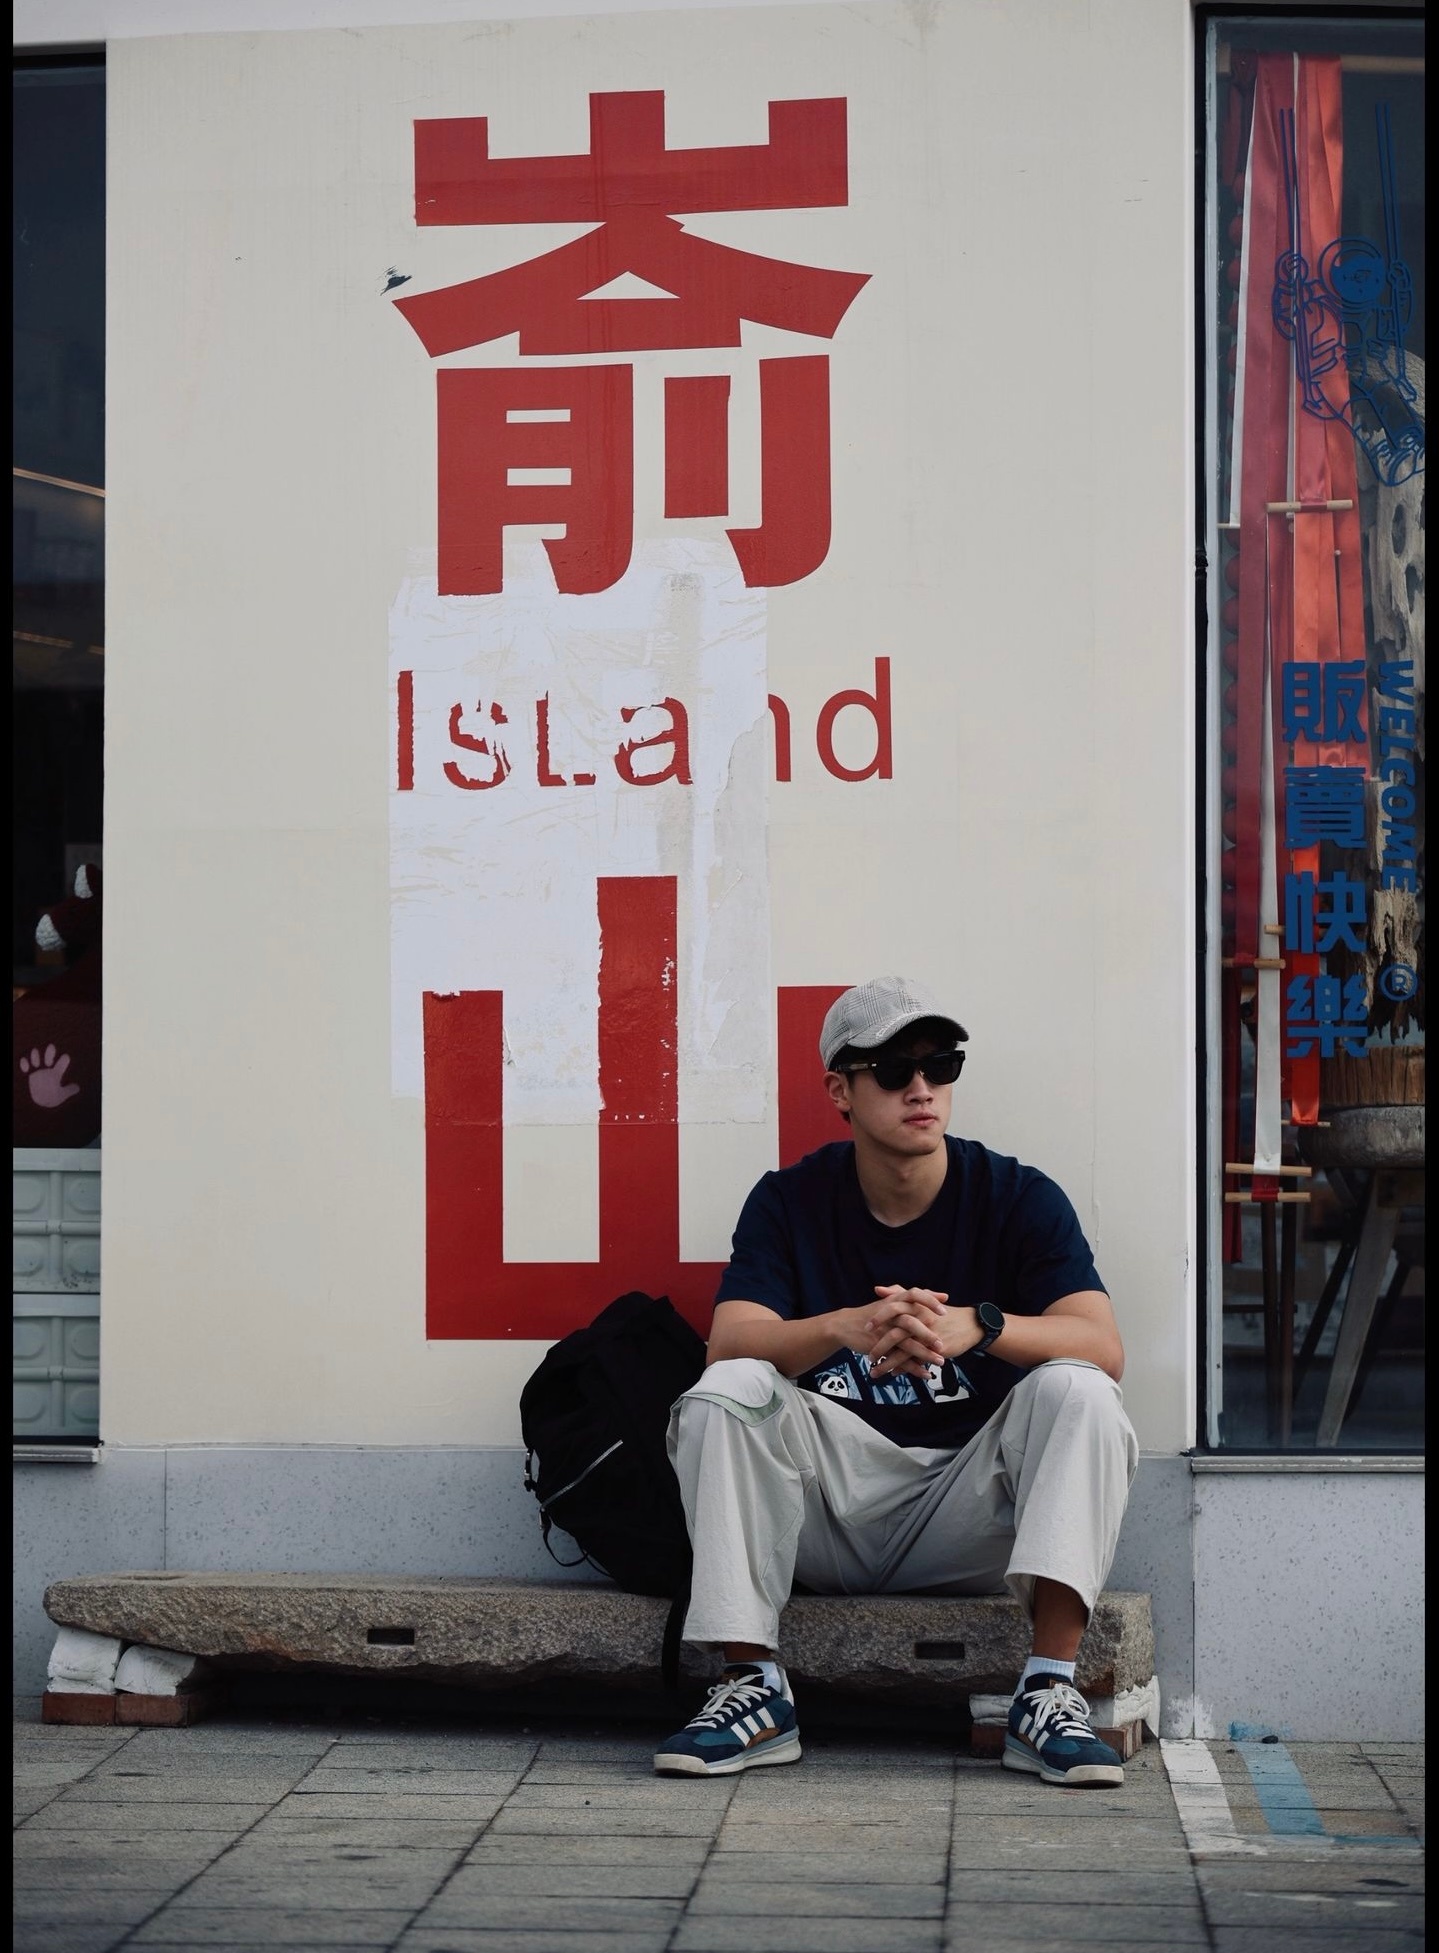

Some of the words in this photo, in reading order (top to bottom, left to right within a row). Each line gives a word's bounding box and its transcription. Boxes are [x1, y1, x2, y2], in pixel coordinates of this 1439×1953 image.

[1282, 660, 1369, 1058] 販賣快樂
[1378, 660, 1417, 894] WELCOME
[423, 876, 857, 1341] 山
